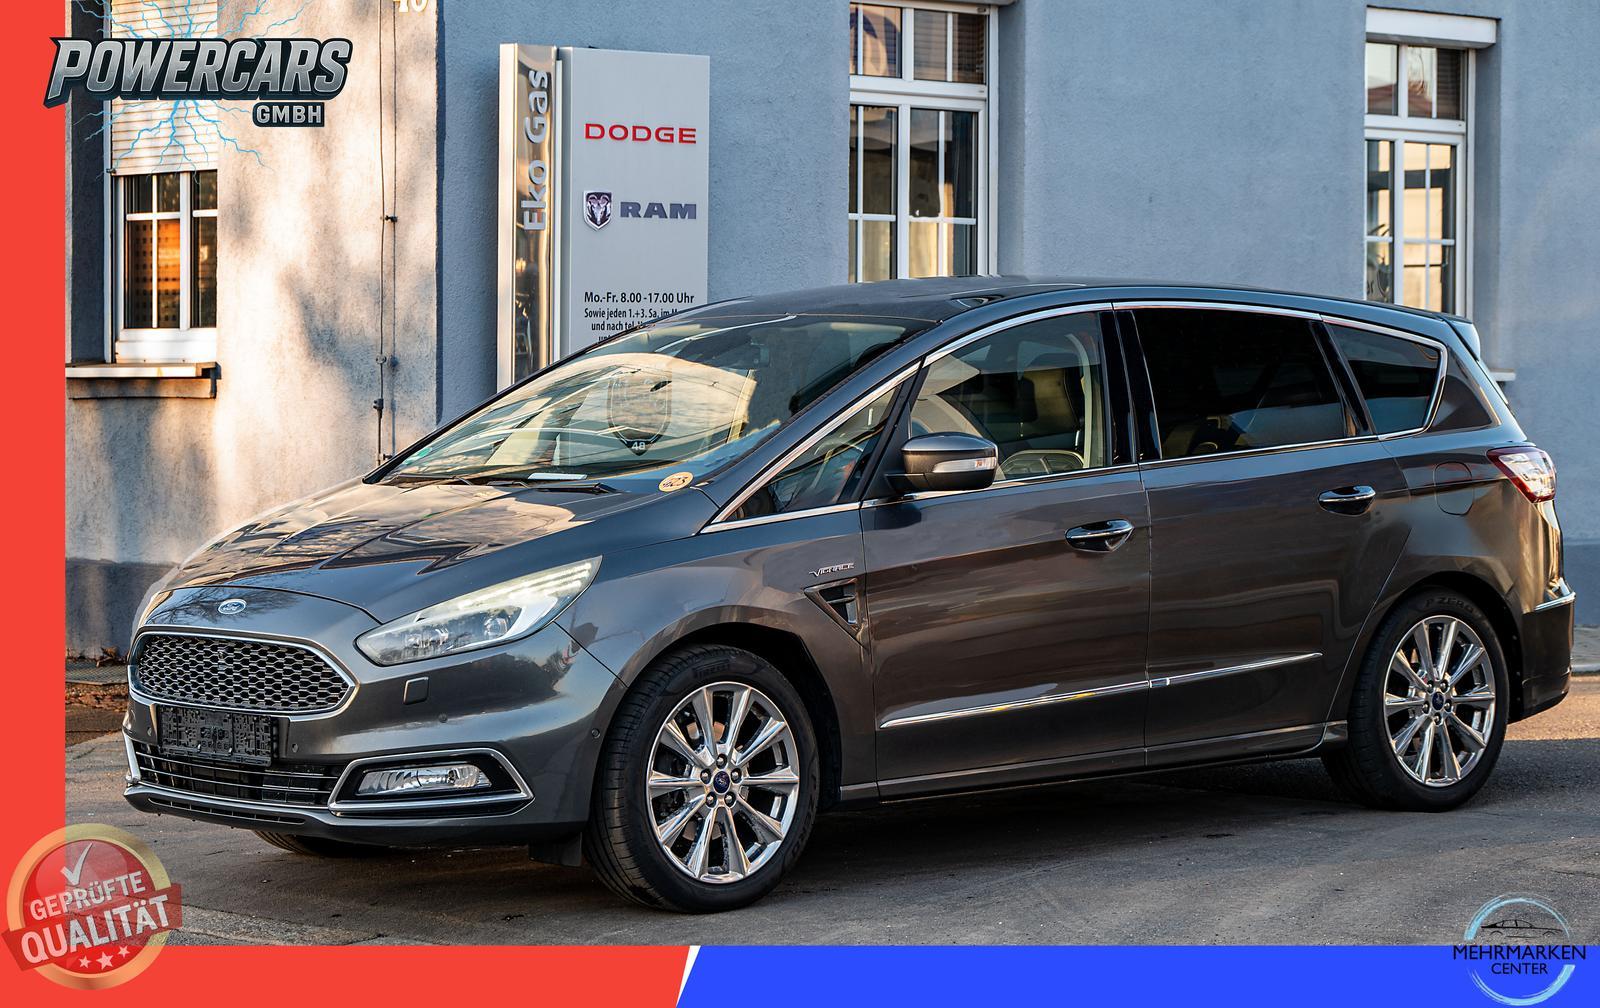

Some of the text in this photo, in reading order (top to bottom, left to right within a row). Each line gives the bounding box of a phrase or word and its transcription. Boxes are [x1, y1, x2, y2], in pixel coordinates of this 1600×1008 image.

[584, 123, 697, 144] DODGE
[521, 70, 549, 231] Eko Gas
[620, 201, 697, 220] RAM
[676, 291, 695, 304] Uhr
[584, 307, 606, 318] Sowie
[606, 307, 627, 320] jeden
[591, 321, 605, 331] und
[606, 321, 624, 331] nach
